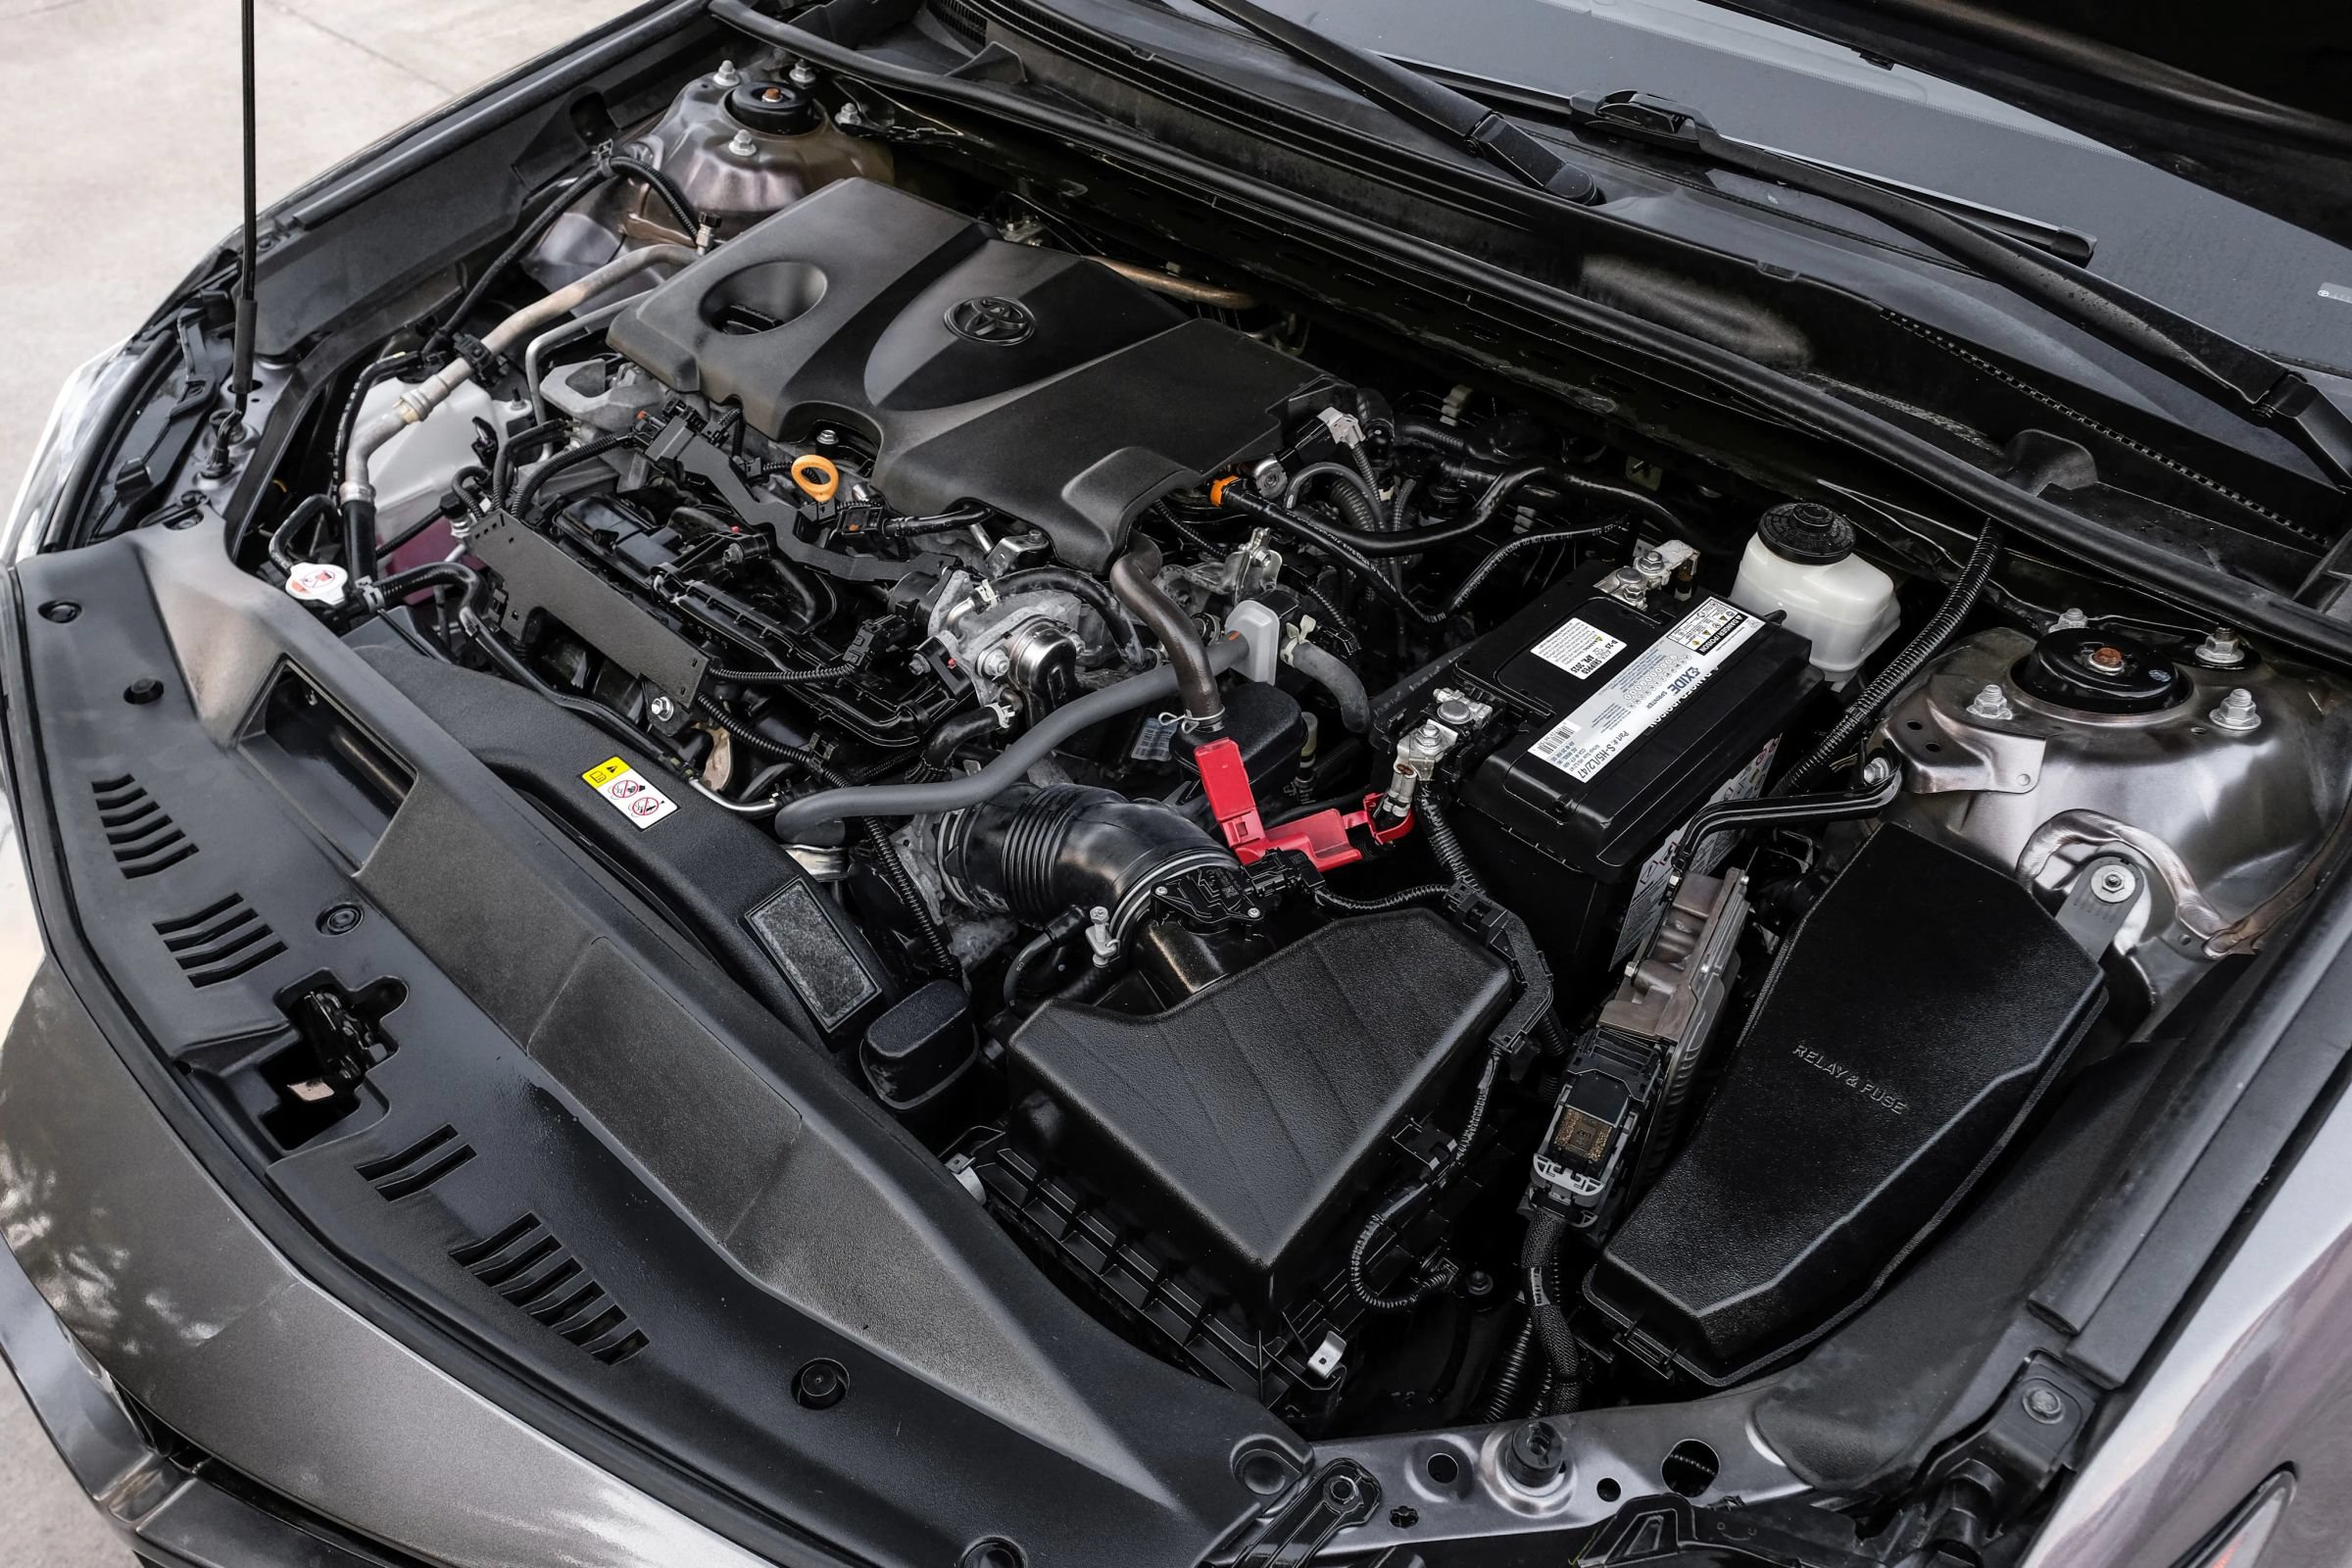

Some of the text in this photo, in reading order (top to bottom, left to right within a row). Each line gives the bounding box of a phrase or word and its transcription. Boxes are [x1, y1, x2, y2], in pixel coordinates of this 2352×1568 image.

[1716, 618, 1739, 636] DANGER
[1569, 662, 1585, 673] 2025
[1581, 659, 1602, 674] SHIPPED
[1667, 665, 1702, 694] EXIDE
[1646, 690, 1668, 710] SPRINTER
[1614, 729, 1630, 741] Part
[1574, 743, 1617, 778] S-H5/L2/47
[1792, 1044, 1849, 1079] RELAY
[1859, 1083, 1910, 1114] FUSE
